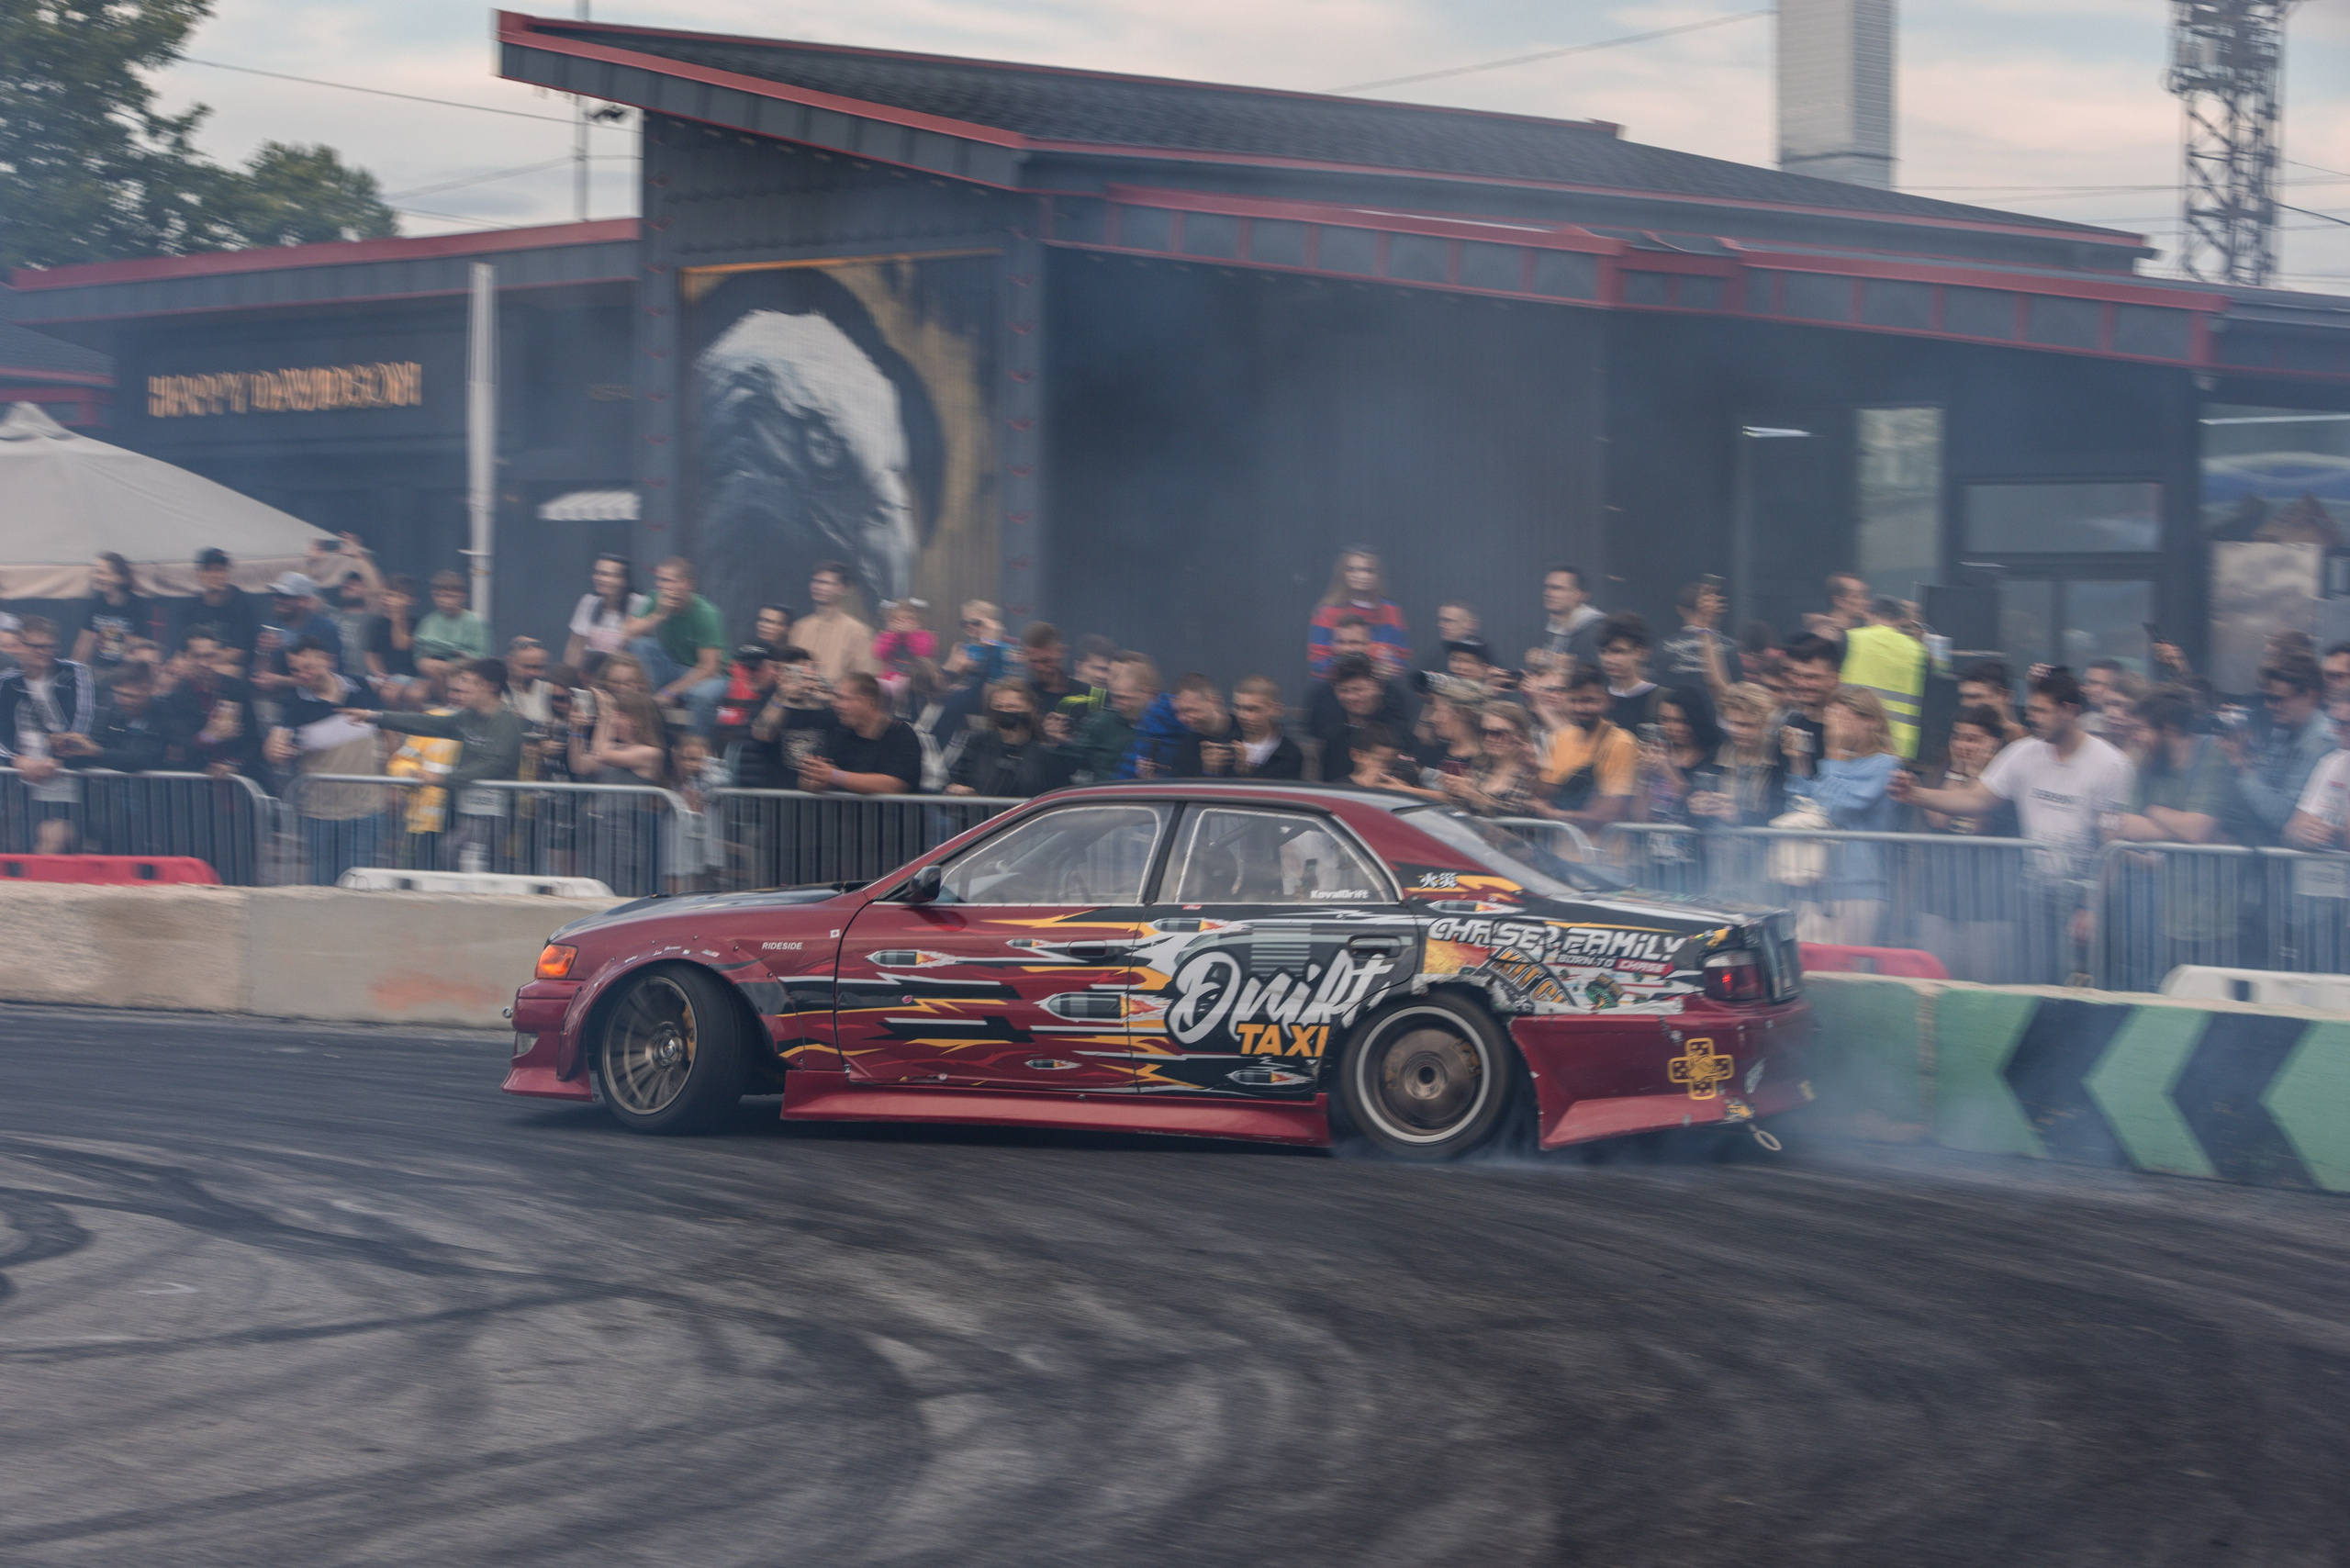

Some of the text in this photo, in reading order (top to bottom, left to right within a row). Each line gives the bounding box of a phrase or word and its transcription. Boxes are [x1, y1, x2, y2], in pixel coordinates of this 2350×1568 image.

[1419, 872, 1459, 889] 火災
[1310, 889, 1370, 900] KovalDrift
[1427, 917, 1561, 951] CHASER
[761, 942, 803, 951] RIDESIDE
[1595, 958, 1617, 969] TO
[1618, 959, 1668, 973] CHASE
[1168, 948, 1395, 1044] Drift
[1237, 1024, 1330, 1058] TAXI
